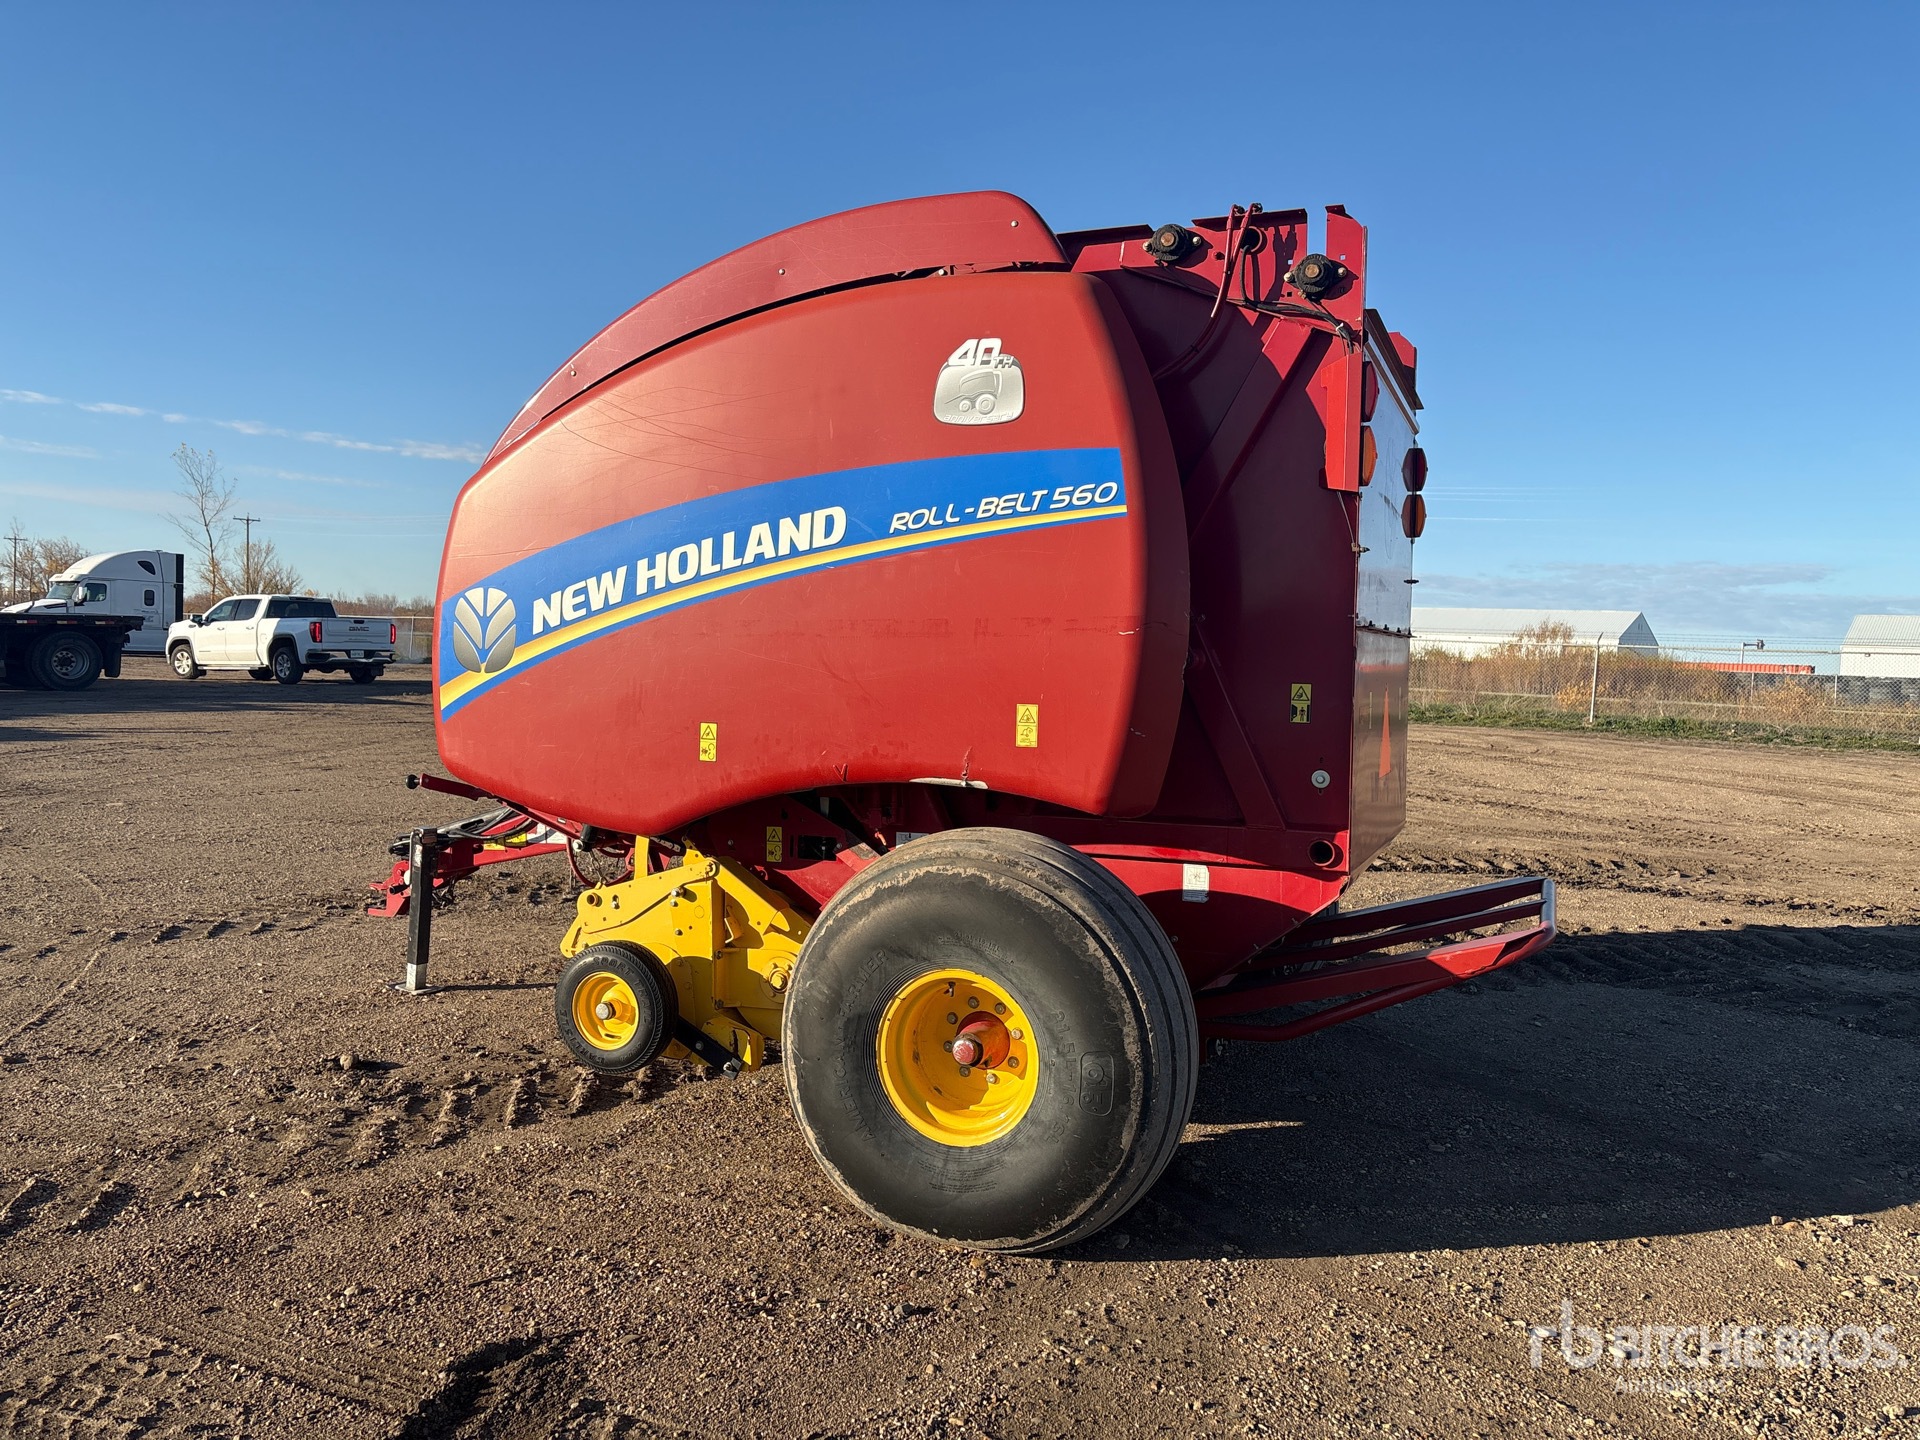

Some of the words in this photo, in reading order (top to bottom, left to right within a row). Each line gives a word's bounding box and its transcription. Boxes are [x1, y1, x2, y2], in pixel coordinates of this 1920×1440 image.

[944, 411, 1014, 423] anniversary
[1049, 481, 1118, 509] 560
[532, 565, 628, 635] NEW
[636, 505, 847, 596] HOLLAND
[592, 956, 635, 976] SPORT
[839, 949, 890, 1019] FARMER
